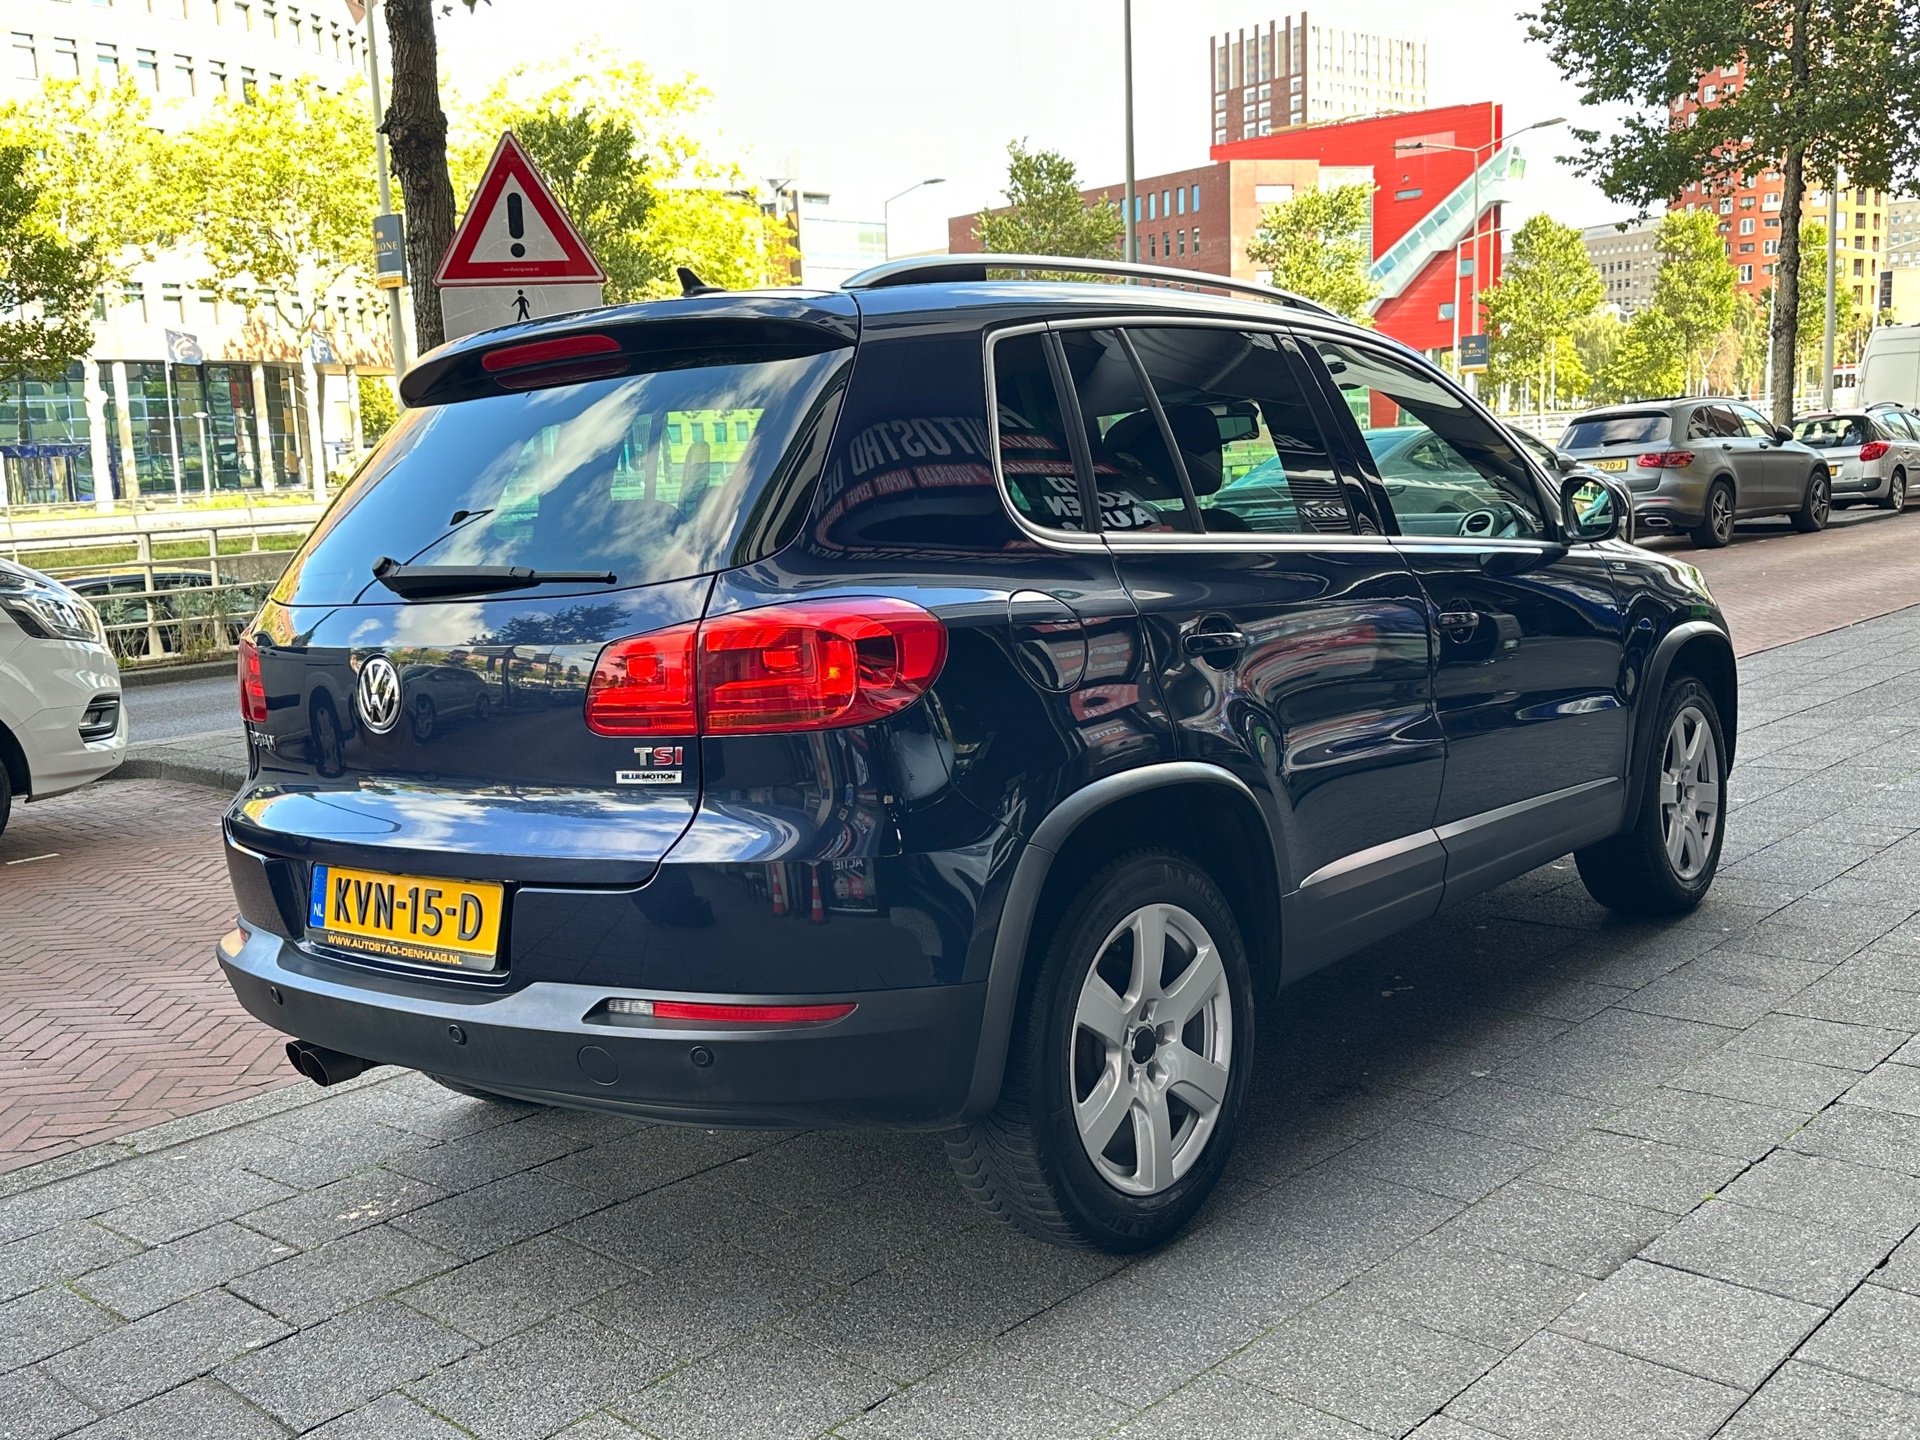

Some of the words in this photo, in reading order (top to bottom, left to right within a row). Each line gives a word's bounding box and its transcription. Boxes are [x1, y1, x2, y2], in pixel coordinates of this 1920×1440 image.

[1590, 461, 1623, 470] -70-J
[633, 746, 684, 767] TSI
[313, 903, 324, 917] NL
[334, 877, 483, 941] KVN-15-D
[327, 934, 463, 965] WWW.AUTOSTAD-DENHAAG.NL
